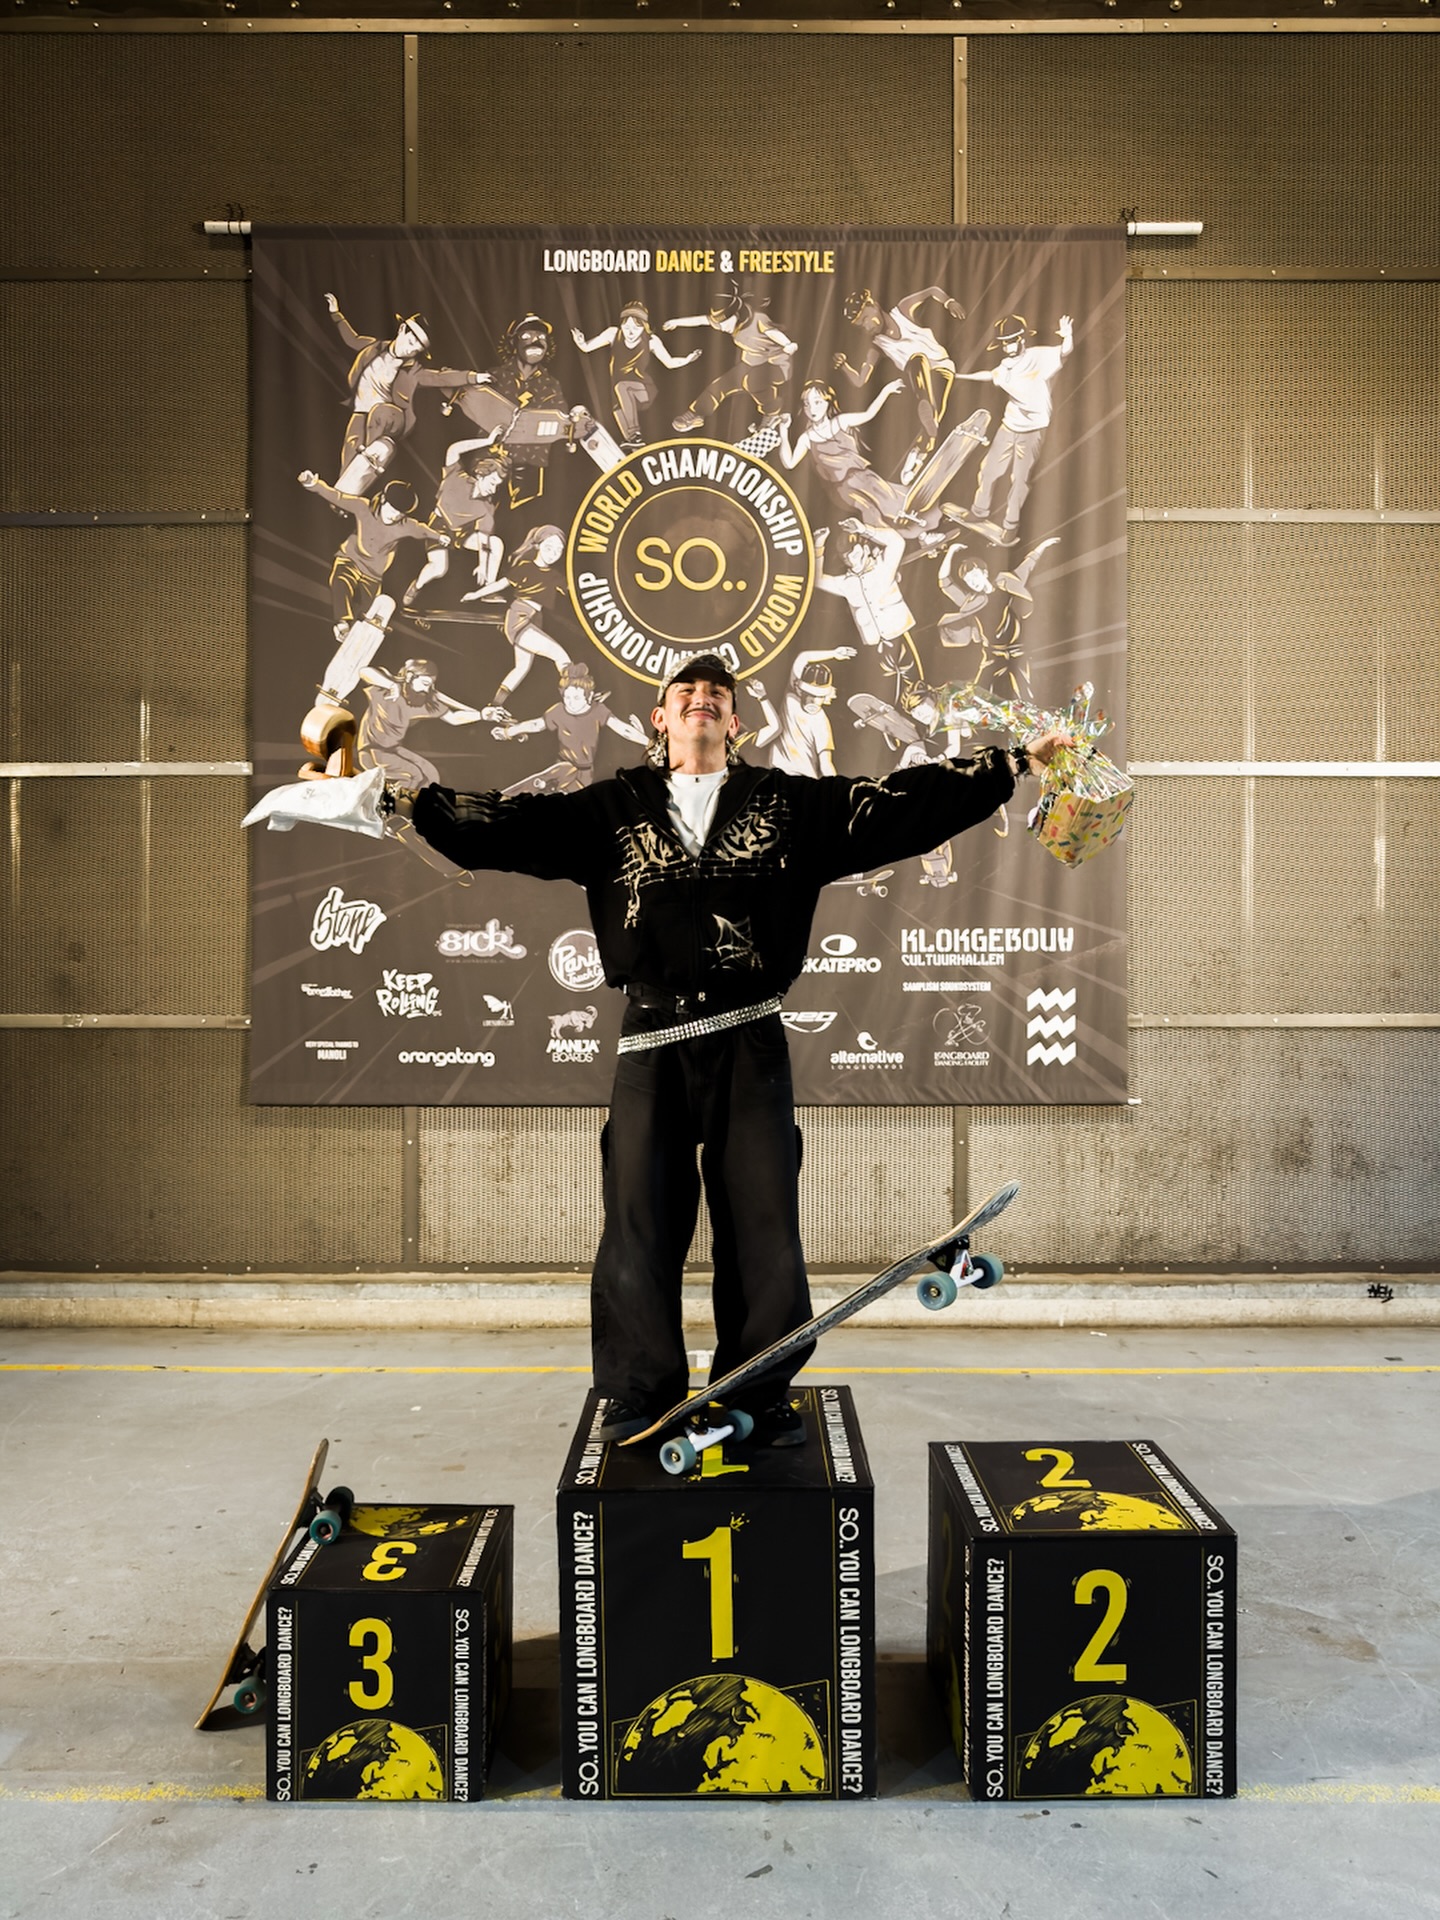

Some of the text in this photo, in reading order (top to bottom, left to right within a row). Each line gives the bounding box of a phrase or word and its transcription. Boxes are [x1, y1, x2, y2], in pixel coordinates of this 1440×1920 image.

[543, 249, 835, 273] LONGBOARD DANCE & FREESTYLE
[577, 448, 804, 556] WORLD CHAMPIONSHIP
[738, 574, 805, 658] WORLD
[900, 927, 1075, 953] KLOKGEBOUW
[901, 953, 1006, 966] CULTUURHALLEN
[382, 968, 434, 994] KEEP
[398, 1047, 496, 1067] orangatang
[551, 1052, 594, 1063] BOARDS
[830, 1050, 904, 1064] alternative
[1024, 1447, 1093, 1489] 2
[362, 1540, 418, 1582] 3
[573, 1510, 596, 1577] DANCE?
[839, 1549, 861, 1584] YOU
[986, 1558, 1005, 1613] DANCE?
[682, 1526, 734, 1660] 1
[839, 1587, 861, 1622] CAN
[1206, 1589, 1224, 1618] YOU
[277, 1606, 293, 1652] DANCE?
[575, 1579, 598, 1679] LONGBOARD
[1073, 1568, 1128, 1683] 2
[1206, 1621, 1224, 1651] CAN
[348, 1616, 395, 1711] 3
[454, 1637, 470, 1660] YOU
[986, 1615, 1005, 1699] LONGBOARD
[276, 1653, 293, 1721] LONGBOARD
[454, 1662, 470, 1685] CAN
[839, 1625, 863, 1725] LONGBOARD
[576, 1682, 599, 1717] CAN
[1205, 1653, 1224, 1738] LONGBOARD
[276, 1723, 292, 1748] CAN
[454, 1688, 470, 1755] LONGBOARD
[986, 1702, 1004, 1732] CAN
[577, 1720, 599, 1754] YOU
[986, 1734, 1004, 1764] YOU
[276, 1749, 292, 1774] YOU
[453, 1757, 469, 1803] DANCE?
[841, 1728, 864, 1795] DANCE?
[1205, 1740, 1224, 1796] DANCE?
